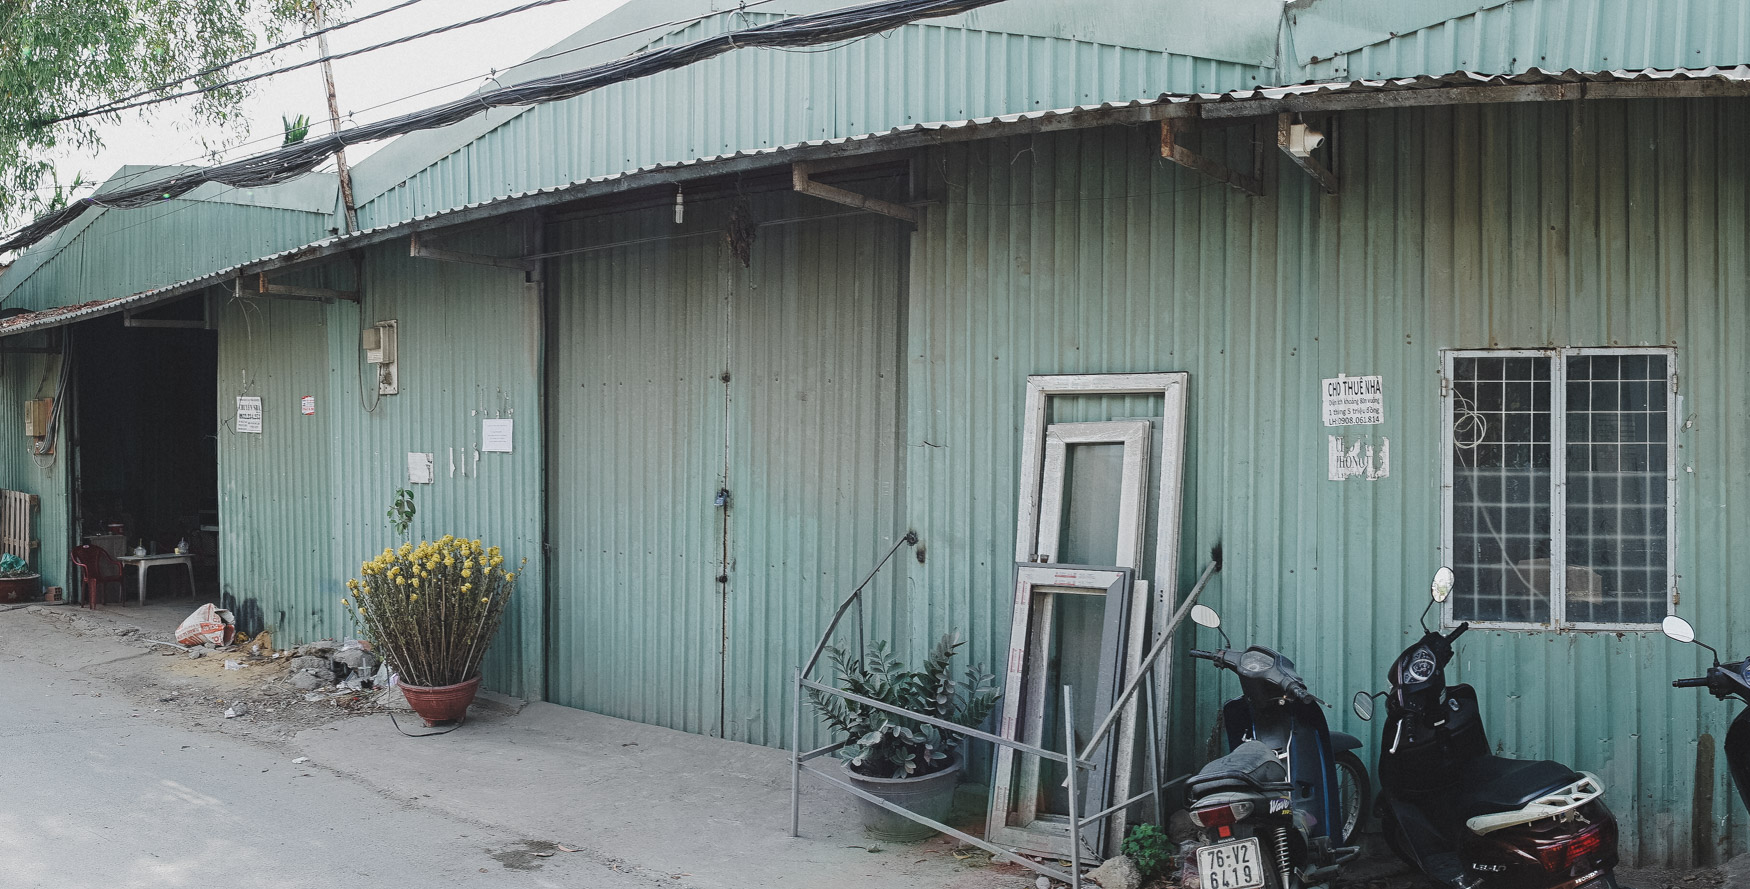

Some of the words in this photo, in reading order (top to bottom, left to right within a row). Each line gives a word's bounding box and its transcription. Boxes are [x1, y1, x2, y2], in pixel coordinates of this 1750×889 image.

[1328, 382, 1341, 397] CHO
[1343, 377, 1363, 396] THUÊ
[1365, 376, 1381, 395] NHÀ
[1269, 799, 1290, 814] Wave
[1207, 845, 1250, 870] 76-V2
